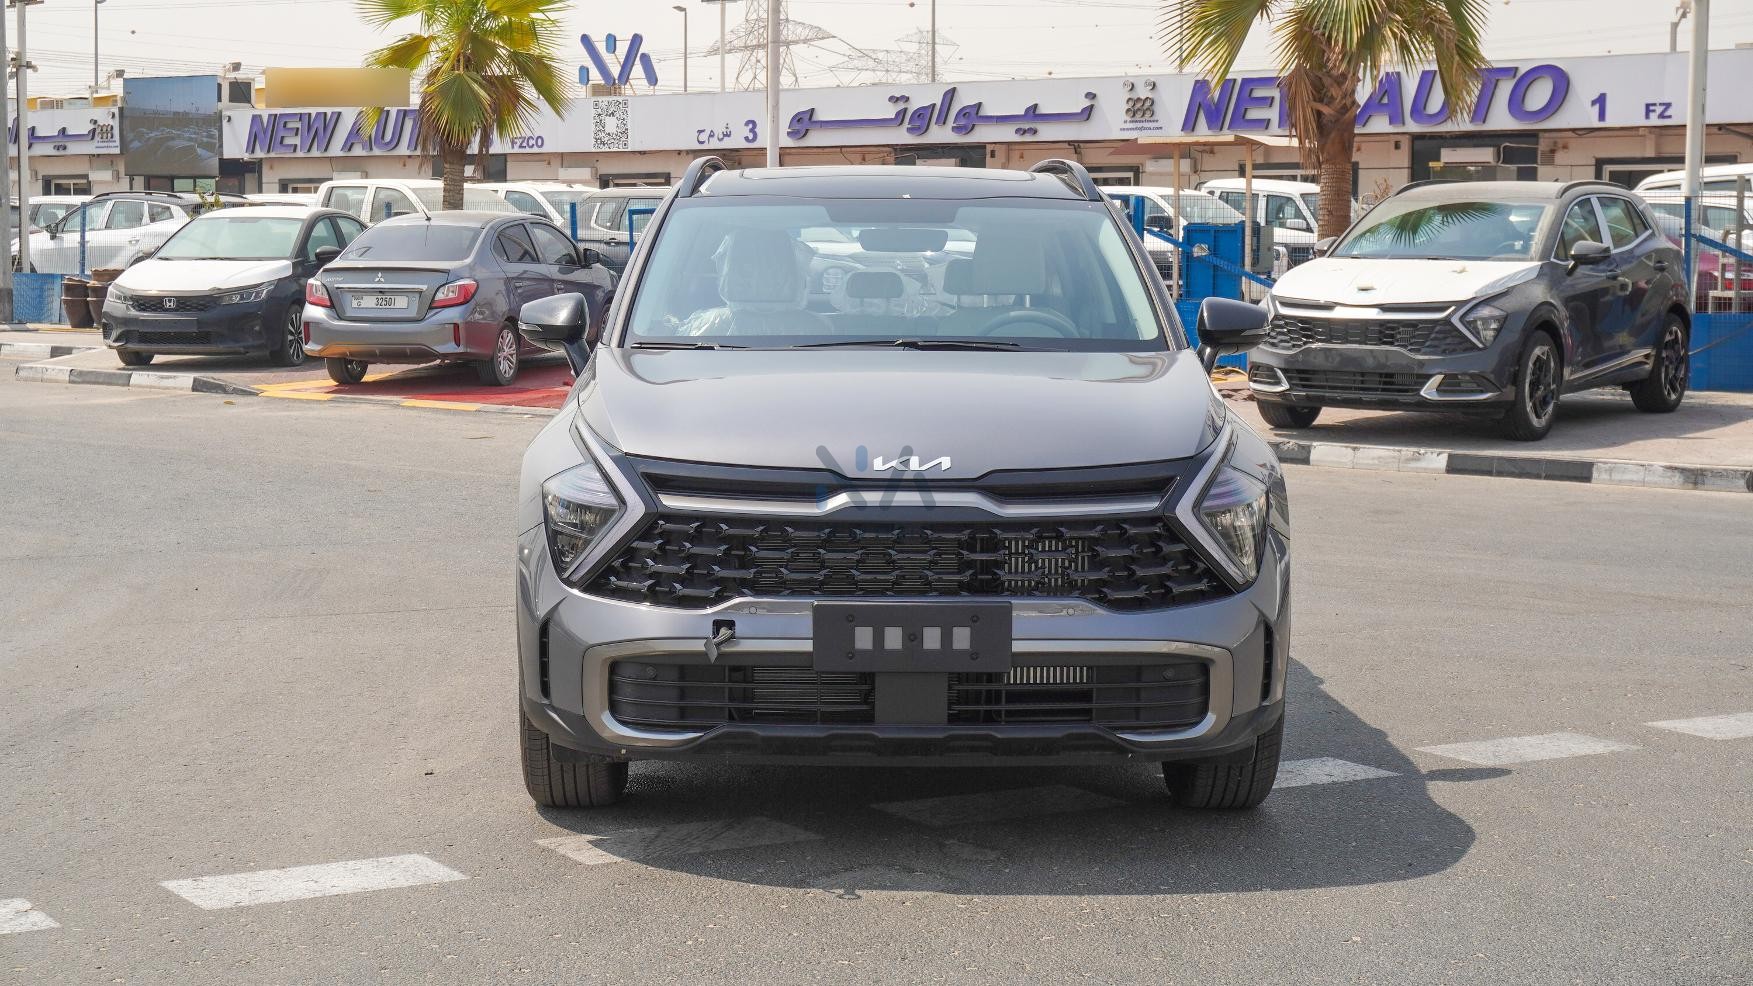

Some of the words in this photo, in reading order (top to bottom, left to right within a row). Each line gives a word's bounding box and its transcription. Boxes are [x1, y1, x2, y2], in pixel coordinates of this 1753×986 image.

[1181, 76, 1291, 132] NE
[1355, 64, 1570, 128] AUTO
[1591, 92, 1607, 122] 1
[1644, 102, 1673, 120] FZ
[245, 110, 342, 155] NEW
[511, 135, 545, 150] FZCO
[744, 119, 758, 143] 3
[375, 297, 396, 307] 32501
